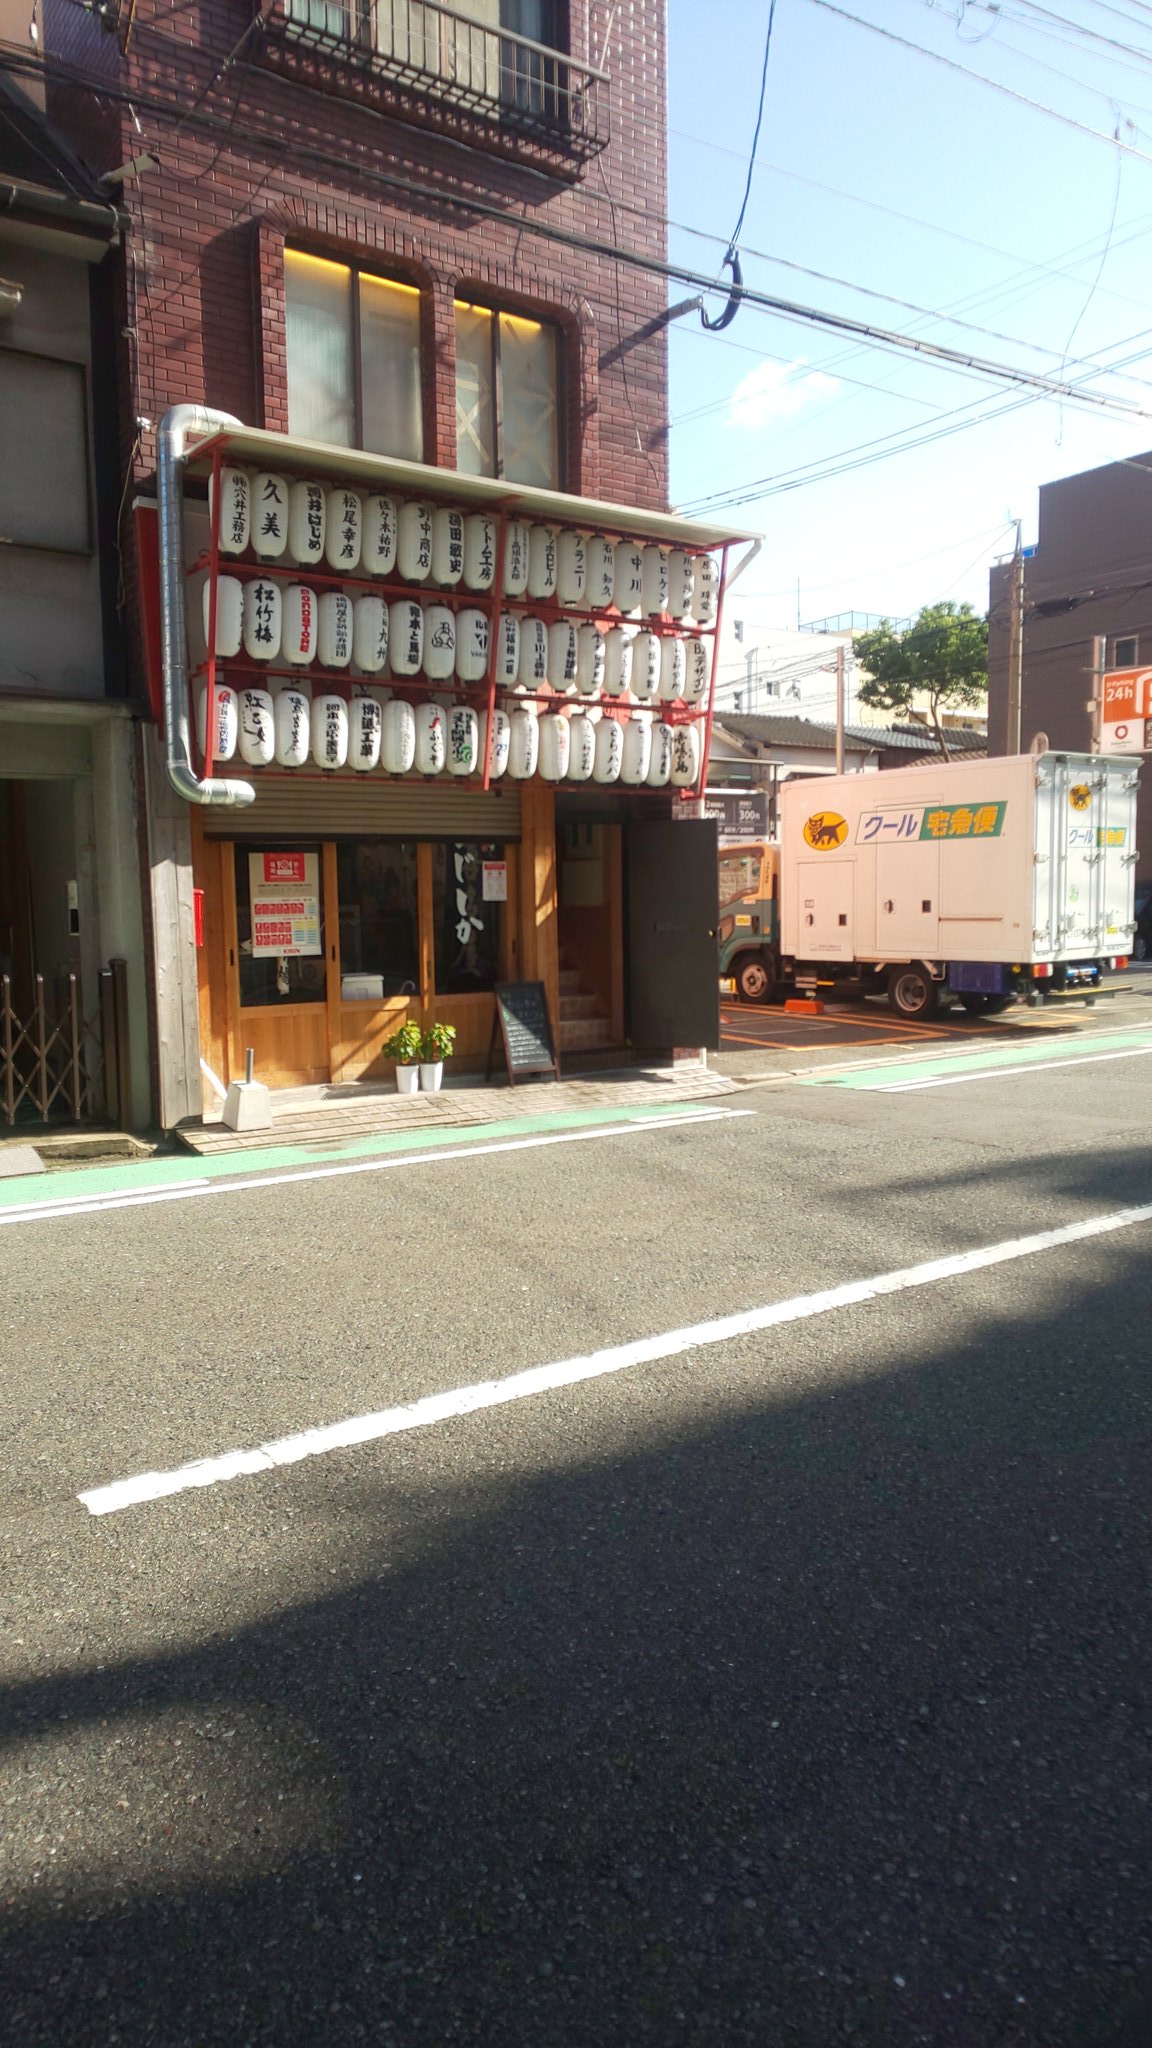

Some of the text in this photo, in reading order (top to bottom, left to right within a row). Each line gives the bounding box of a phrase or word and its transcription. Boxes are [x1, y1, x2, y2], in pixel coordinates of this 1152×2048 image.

[260, 478, 283, 538] 久美
[340, 494, 357, 558] 松尾幸彦
[417, 507, 431, 568] 野中商店
[478, 519, 493, 581] アトム工房
[630, 554, 642, 593] 中川
[254, 583, 275, 643] 松竹梅
[1106, 685, 1133, 702] 24h
[864, 805, 999, 841] クール 宅急便
